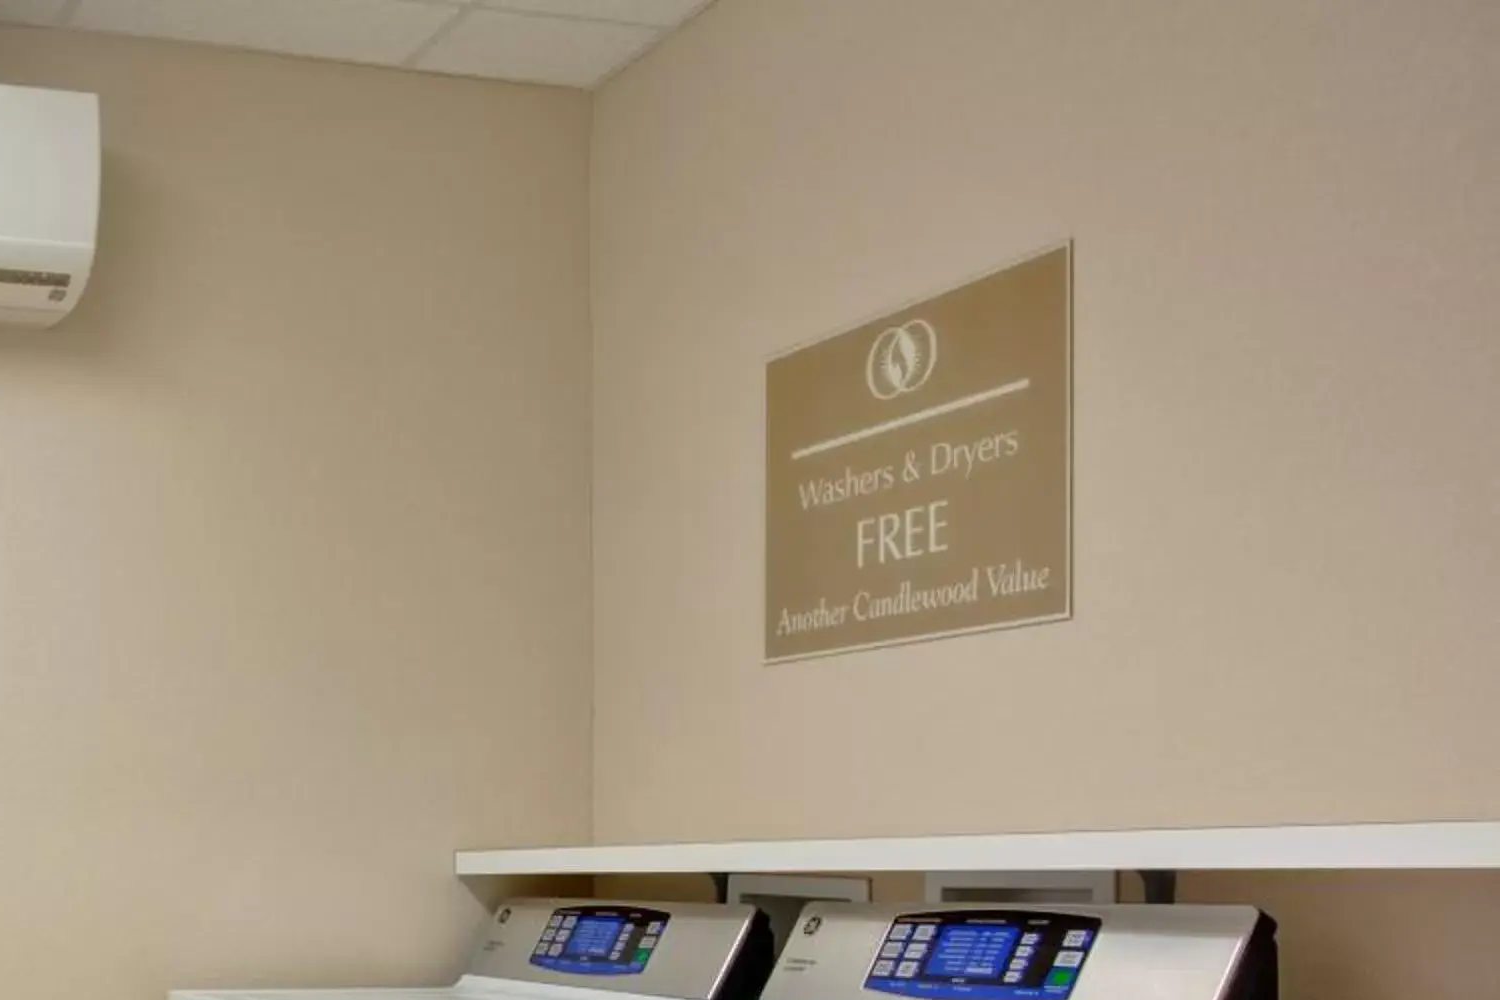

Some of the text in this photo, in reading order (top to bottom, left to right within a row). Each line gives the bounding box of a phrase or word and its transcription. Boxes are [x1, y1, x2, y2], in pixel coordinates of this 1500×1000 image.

[799, 430, 1019, 510] Washers & Dryers
[856, 499, 949, 568] FREE
[776, 558, 1050, 636] Another Candlewood Value
